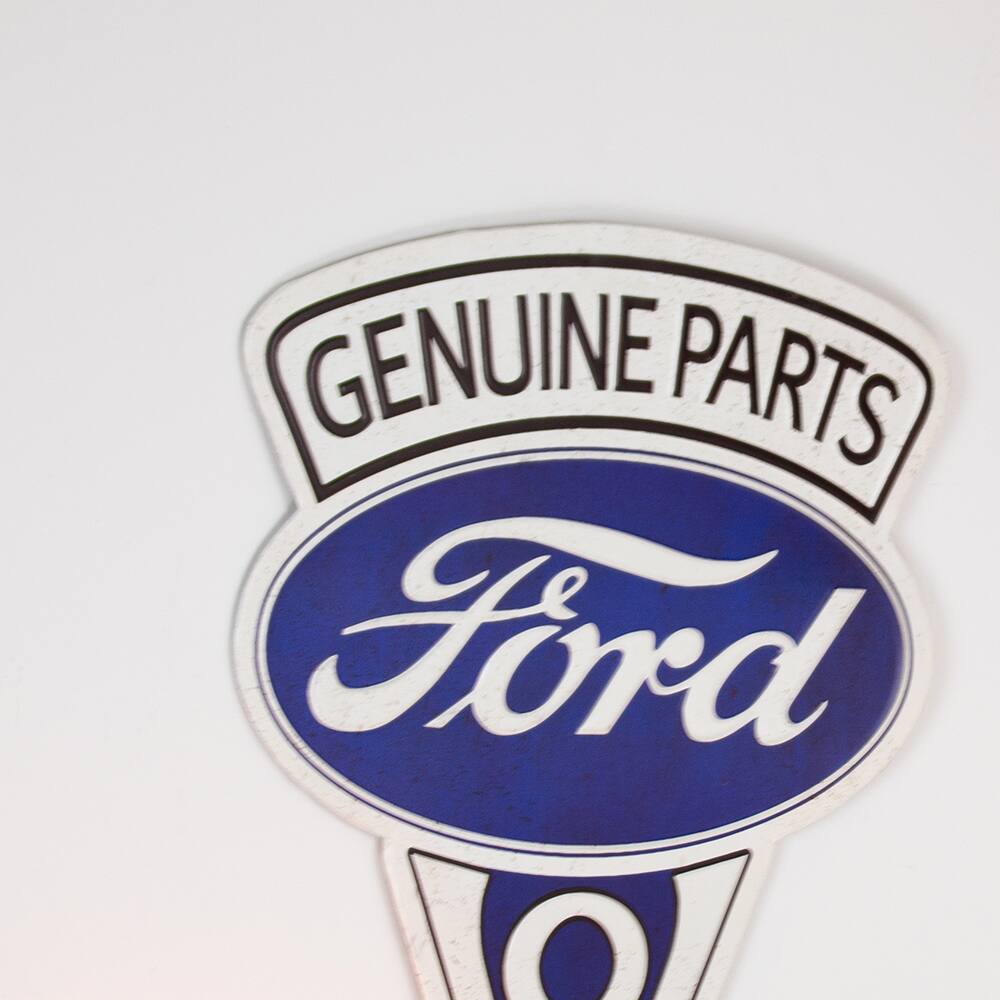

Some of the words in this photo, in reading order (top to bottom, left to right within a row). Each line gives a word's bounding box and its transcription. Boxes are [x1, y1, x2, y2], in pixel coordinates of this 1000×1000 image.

[306, 292, 658, 439] GENUINE
[672, 295, 900, 466] PARTS
[306, 515, 867, 748] Ford
